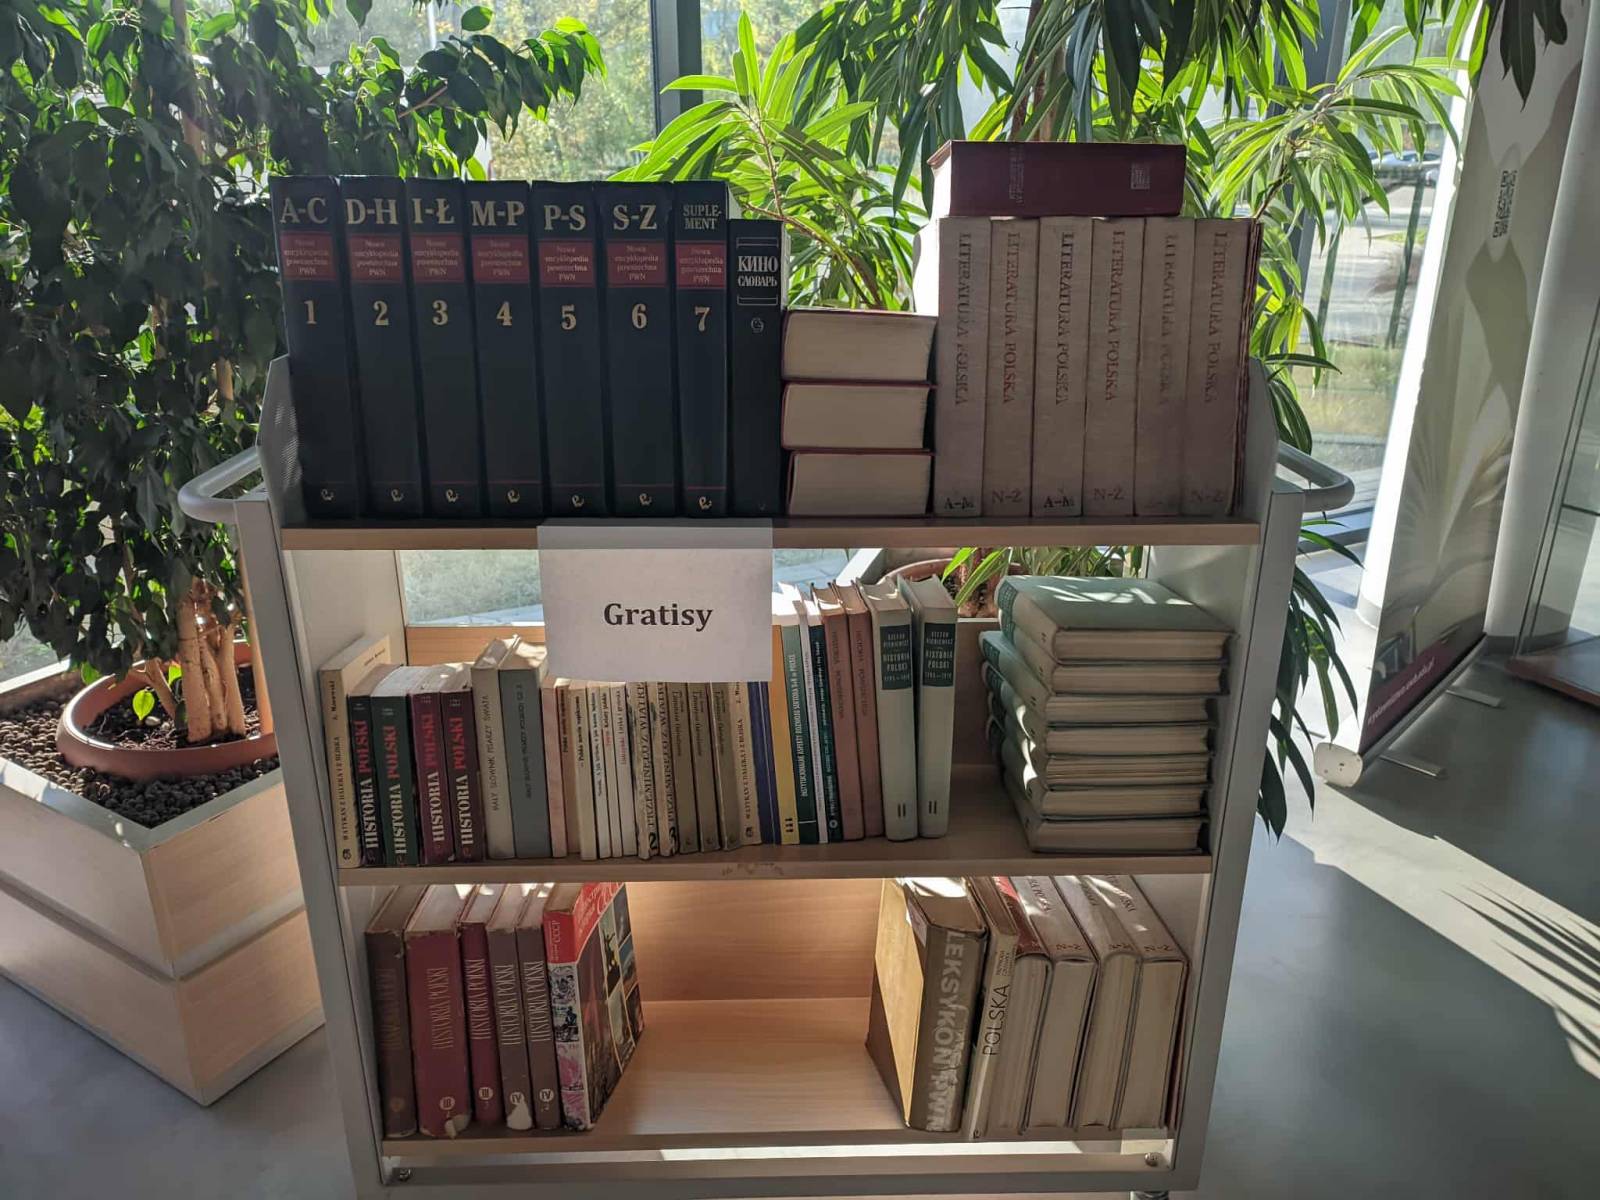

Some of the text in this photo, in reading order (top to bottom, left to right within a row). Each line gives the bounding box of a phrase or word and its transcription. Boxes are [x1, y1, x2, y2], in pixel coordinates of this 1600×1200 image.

[280, 197, 329, 224] A-C
[344, 198, 399, 225] D-H
[411, 198, 455, 224] I-Ł
[471, 200, 525, 226] M-P
[543, 205, 586, 231] P-S
[613, 204, 658, 231] S-Z
[683, 203, 722, 217] SUPLE-
[684, 217, 717, 231] MENT
[559, 273, 577, 281] PWN
[629, 272, 647, 281] PWN
[738, 256, 778, 273] КИНО
[693, 275, 710, 283] PWN
[738, 275, 778, 287] СЛОВАРЬ
[956, 232, 972, 338] LITERATURA
[1208, 231, 1227, 337] LITERATURA
[304, 299, 318, 325] 1
[373, 300, 389, 326] 2
[432, 300, 448, 326] 3
[496, 301, 512, 326] 4
[561, 304, 577, 330] 5
[631, 303, 648, 329] 6
[694, 306, 711, 332] 7
[1002, 232, 1020, 404] LITERATURA POLSKA
[1056, 232, 1074, 405] LITERATURA POLSKA
[1105, 230, 1125, 401] LITERATURA POLSKA
[603, 603, 714, 632] Gratisy
[636, 681, 647, 730] WIATRE
[354, 720, 370, 773] POLSKI
[383, 725, 398, 778] POLSKI
[421, 712, 437, 768] POLSKI
[448, 716, 466, 769] POLSKI
[359, 777, 378, 848] HISTORIA
[389, 783, 407, 854] HISTORIA
[427, 772, 445, 841] HISTORIA
[455, 775, 474, 845] HISTORIA
[648, 831, 657, 849] 2
[668, 825, 677, 844] 3
[426, 966, 453, 1048] HISTORIA POLSKI
[464, 957, 491, 1039] HISTORIA POLSKI
[493, 962, 521, 1045] HISTORIA POLSKI
[523, 959, 551, 1042] HISTORIA POLSKI
[933, 931, 964, 1067] LEKSYKON
[982, 983, 1010, 1055] POLSKA
